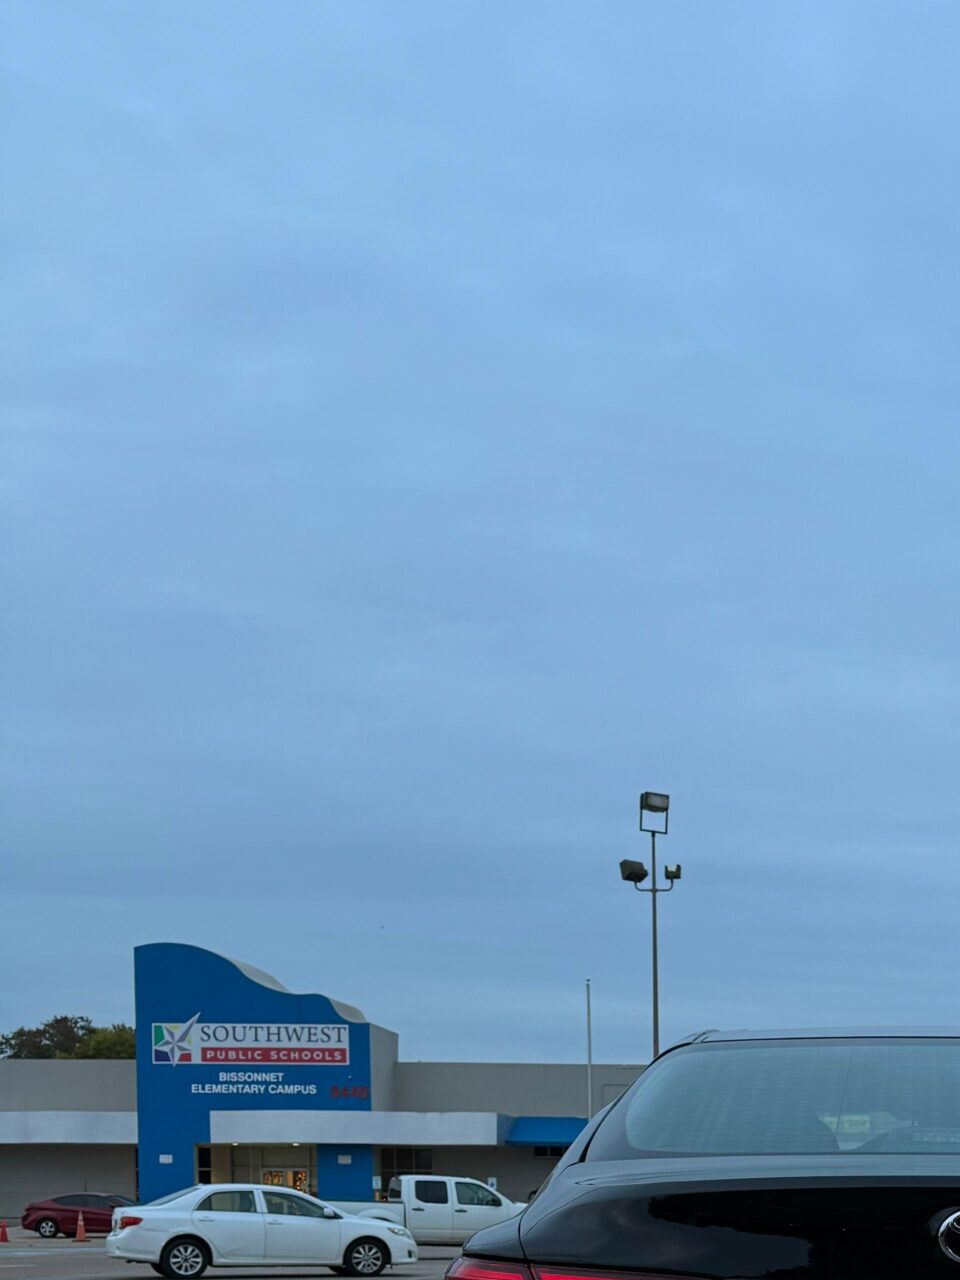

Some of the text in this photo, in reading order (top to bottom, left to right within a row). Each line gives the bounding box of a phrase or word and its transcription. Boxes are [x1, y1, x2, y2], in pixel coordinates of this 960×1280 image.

[200, 1025, 347, 1043] SOUTHWEST
[206, 1050, 343, 1061] PUBLIC SCHOOLS
[219, 1072, 285, 1082] BISSONNET
[191, 1084, 317, 1095] ELEMENTARY CAMPUS
